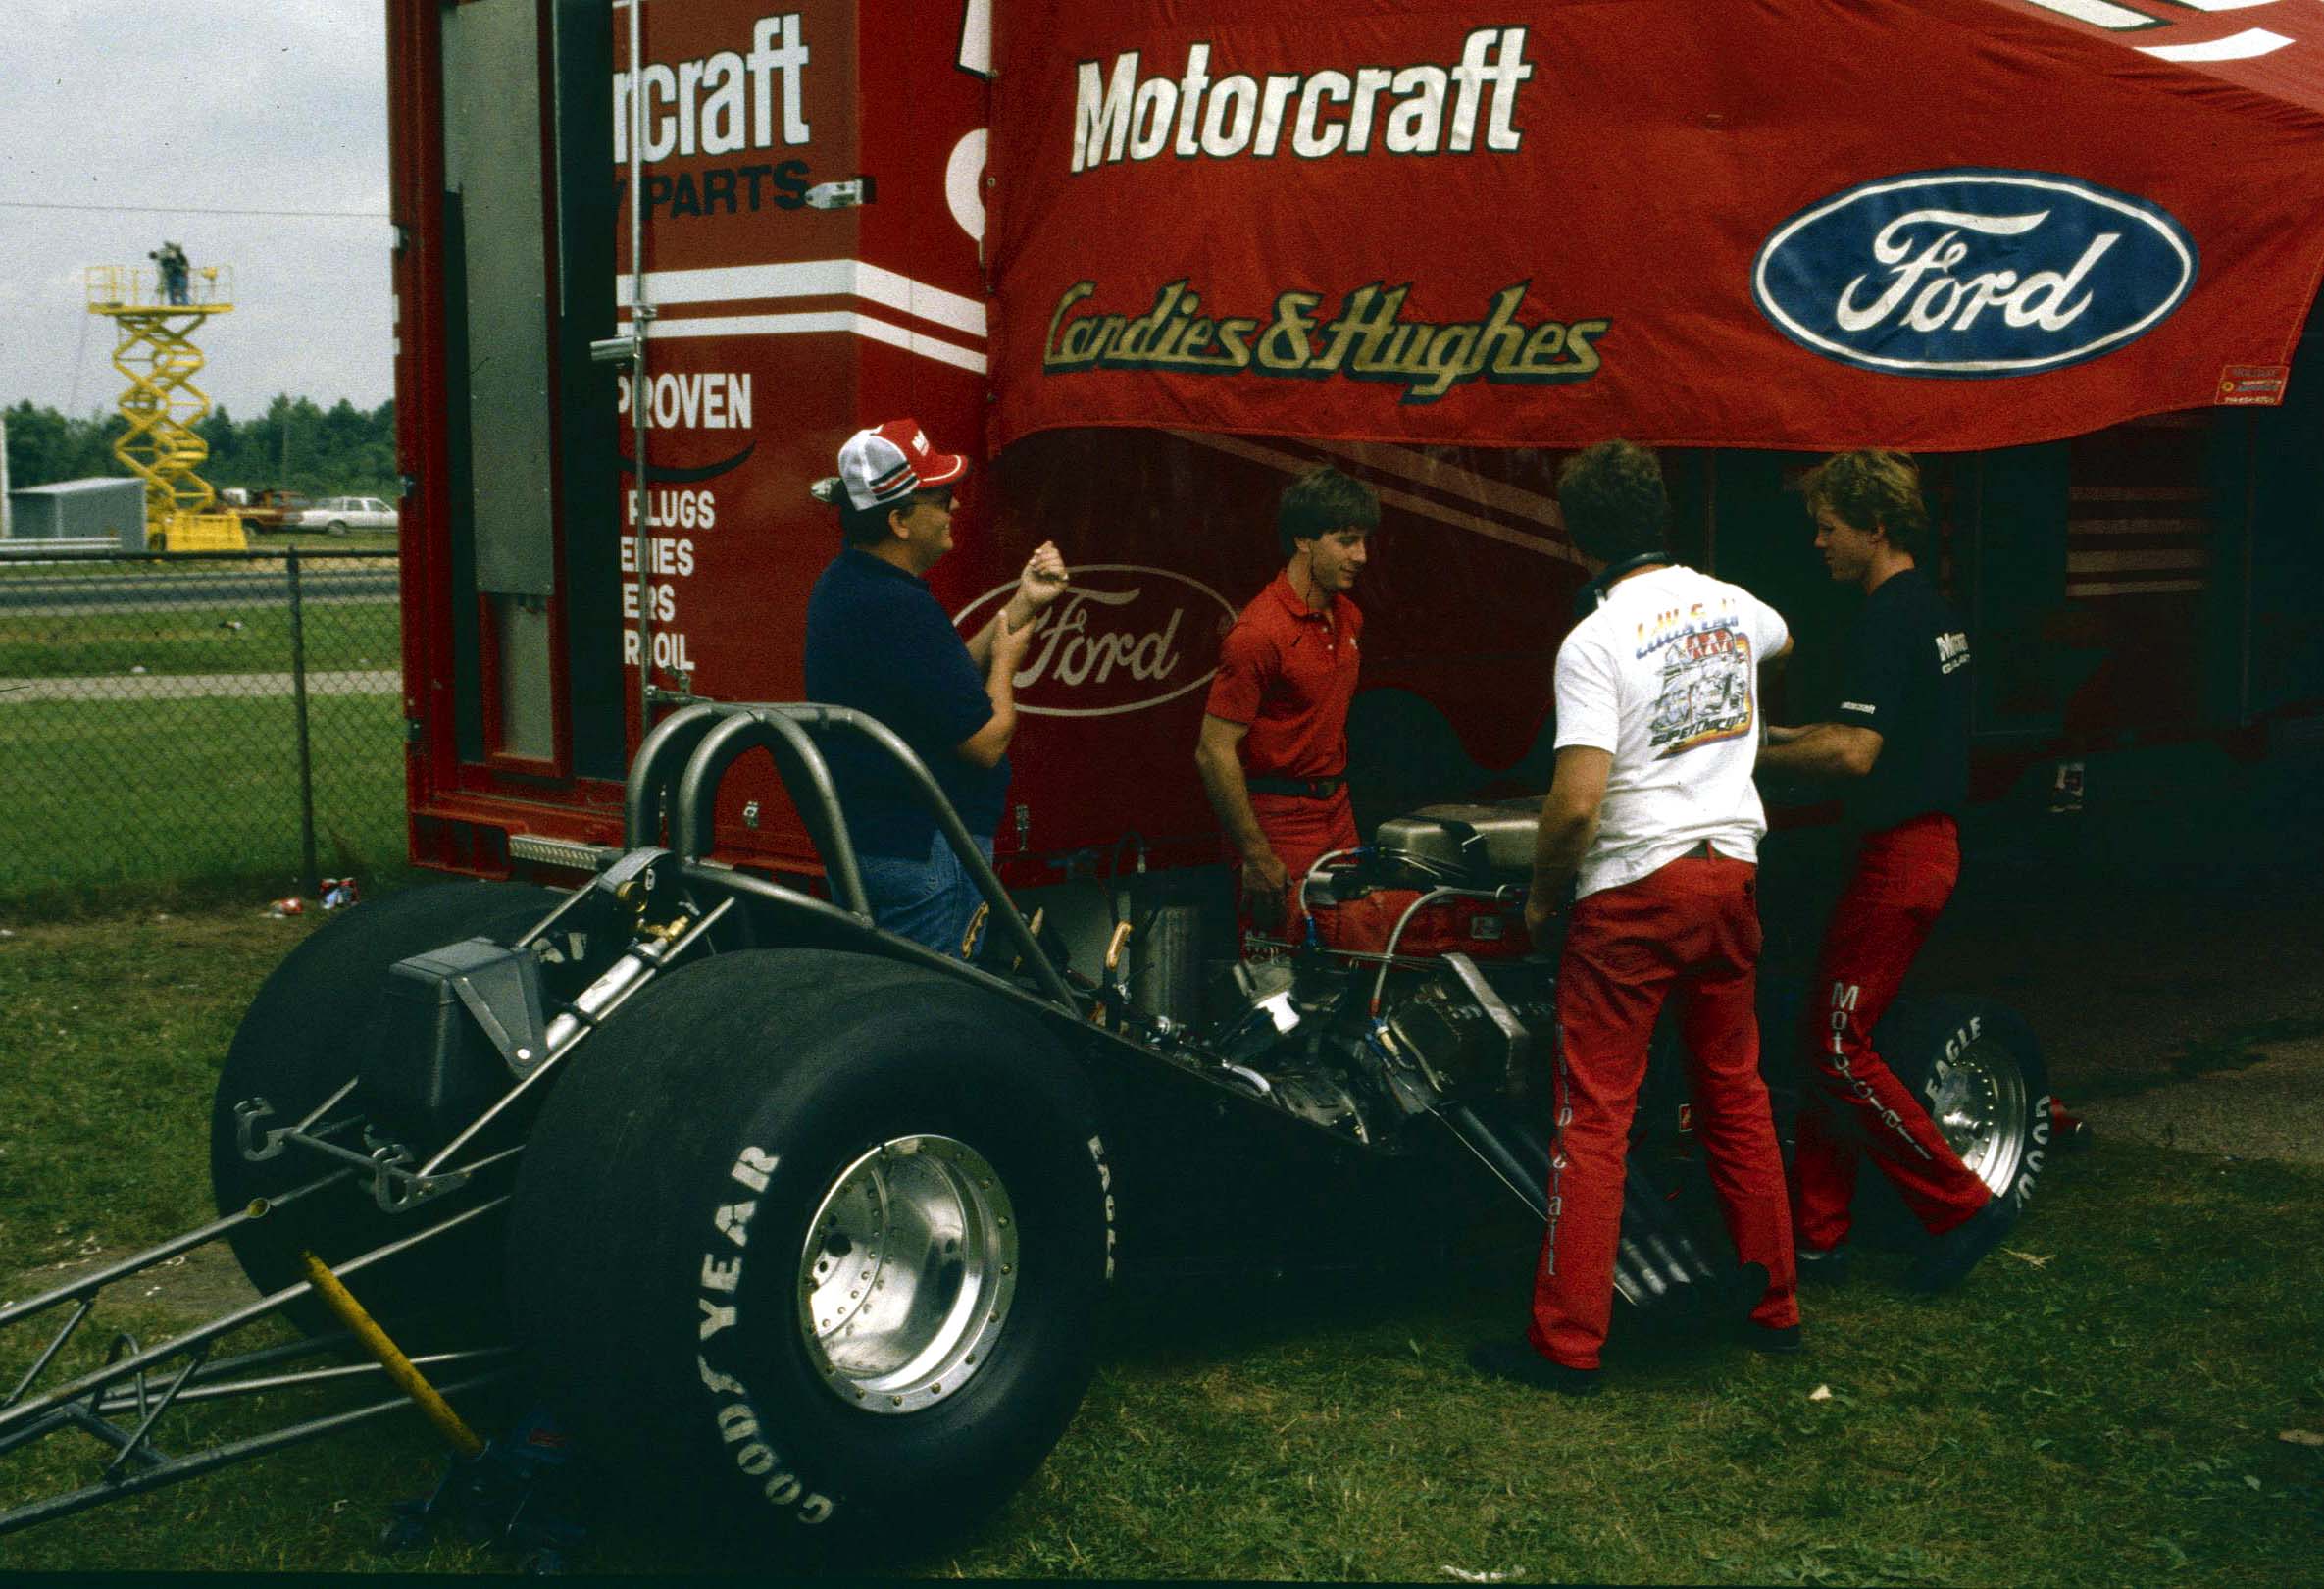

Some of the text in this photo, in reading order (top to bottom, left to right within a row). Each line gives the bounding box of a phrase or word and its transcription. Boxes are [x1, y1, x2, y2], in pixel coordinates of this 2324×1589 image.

[1071, 26, 1532, 173] Motorcraft
[1837, 209, 2122, 333] Ford
[1013, 588, 1184, 689] Ford
